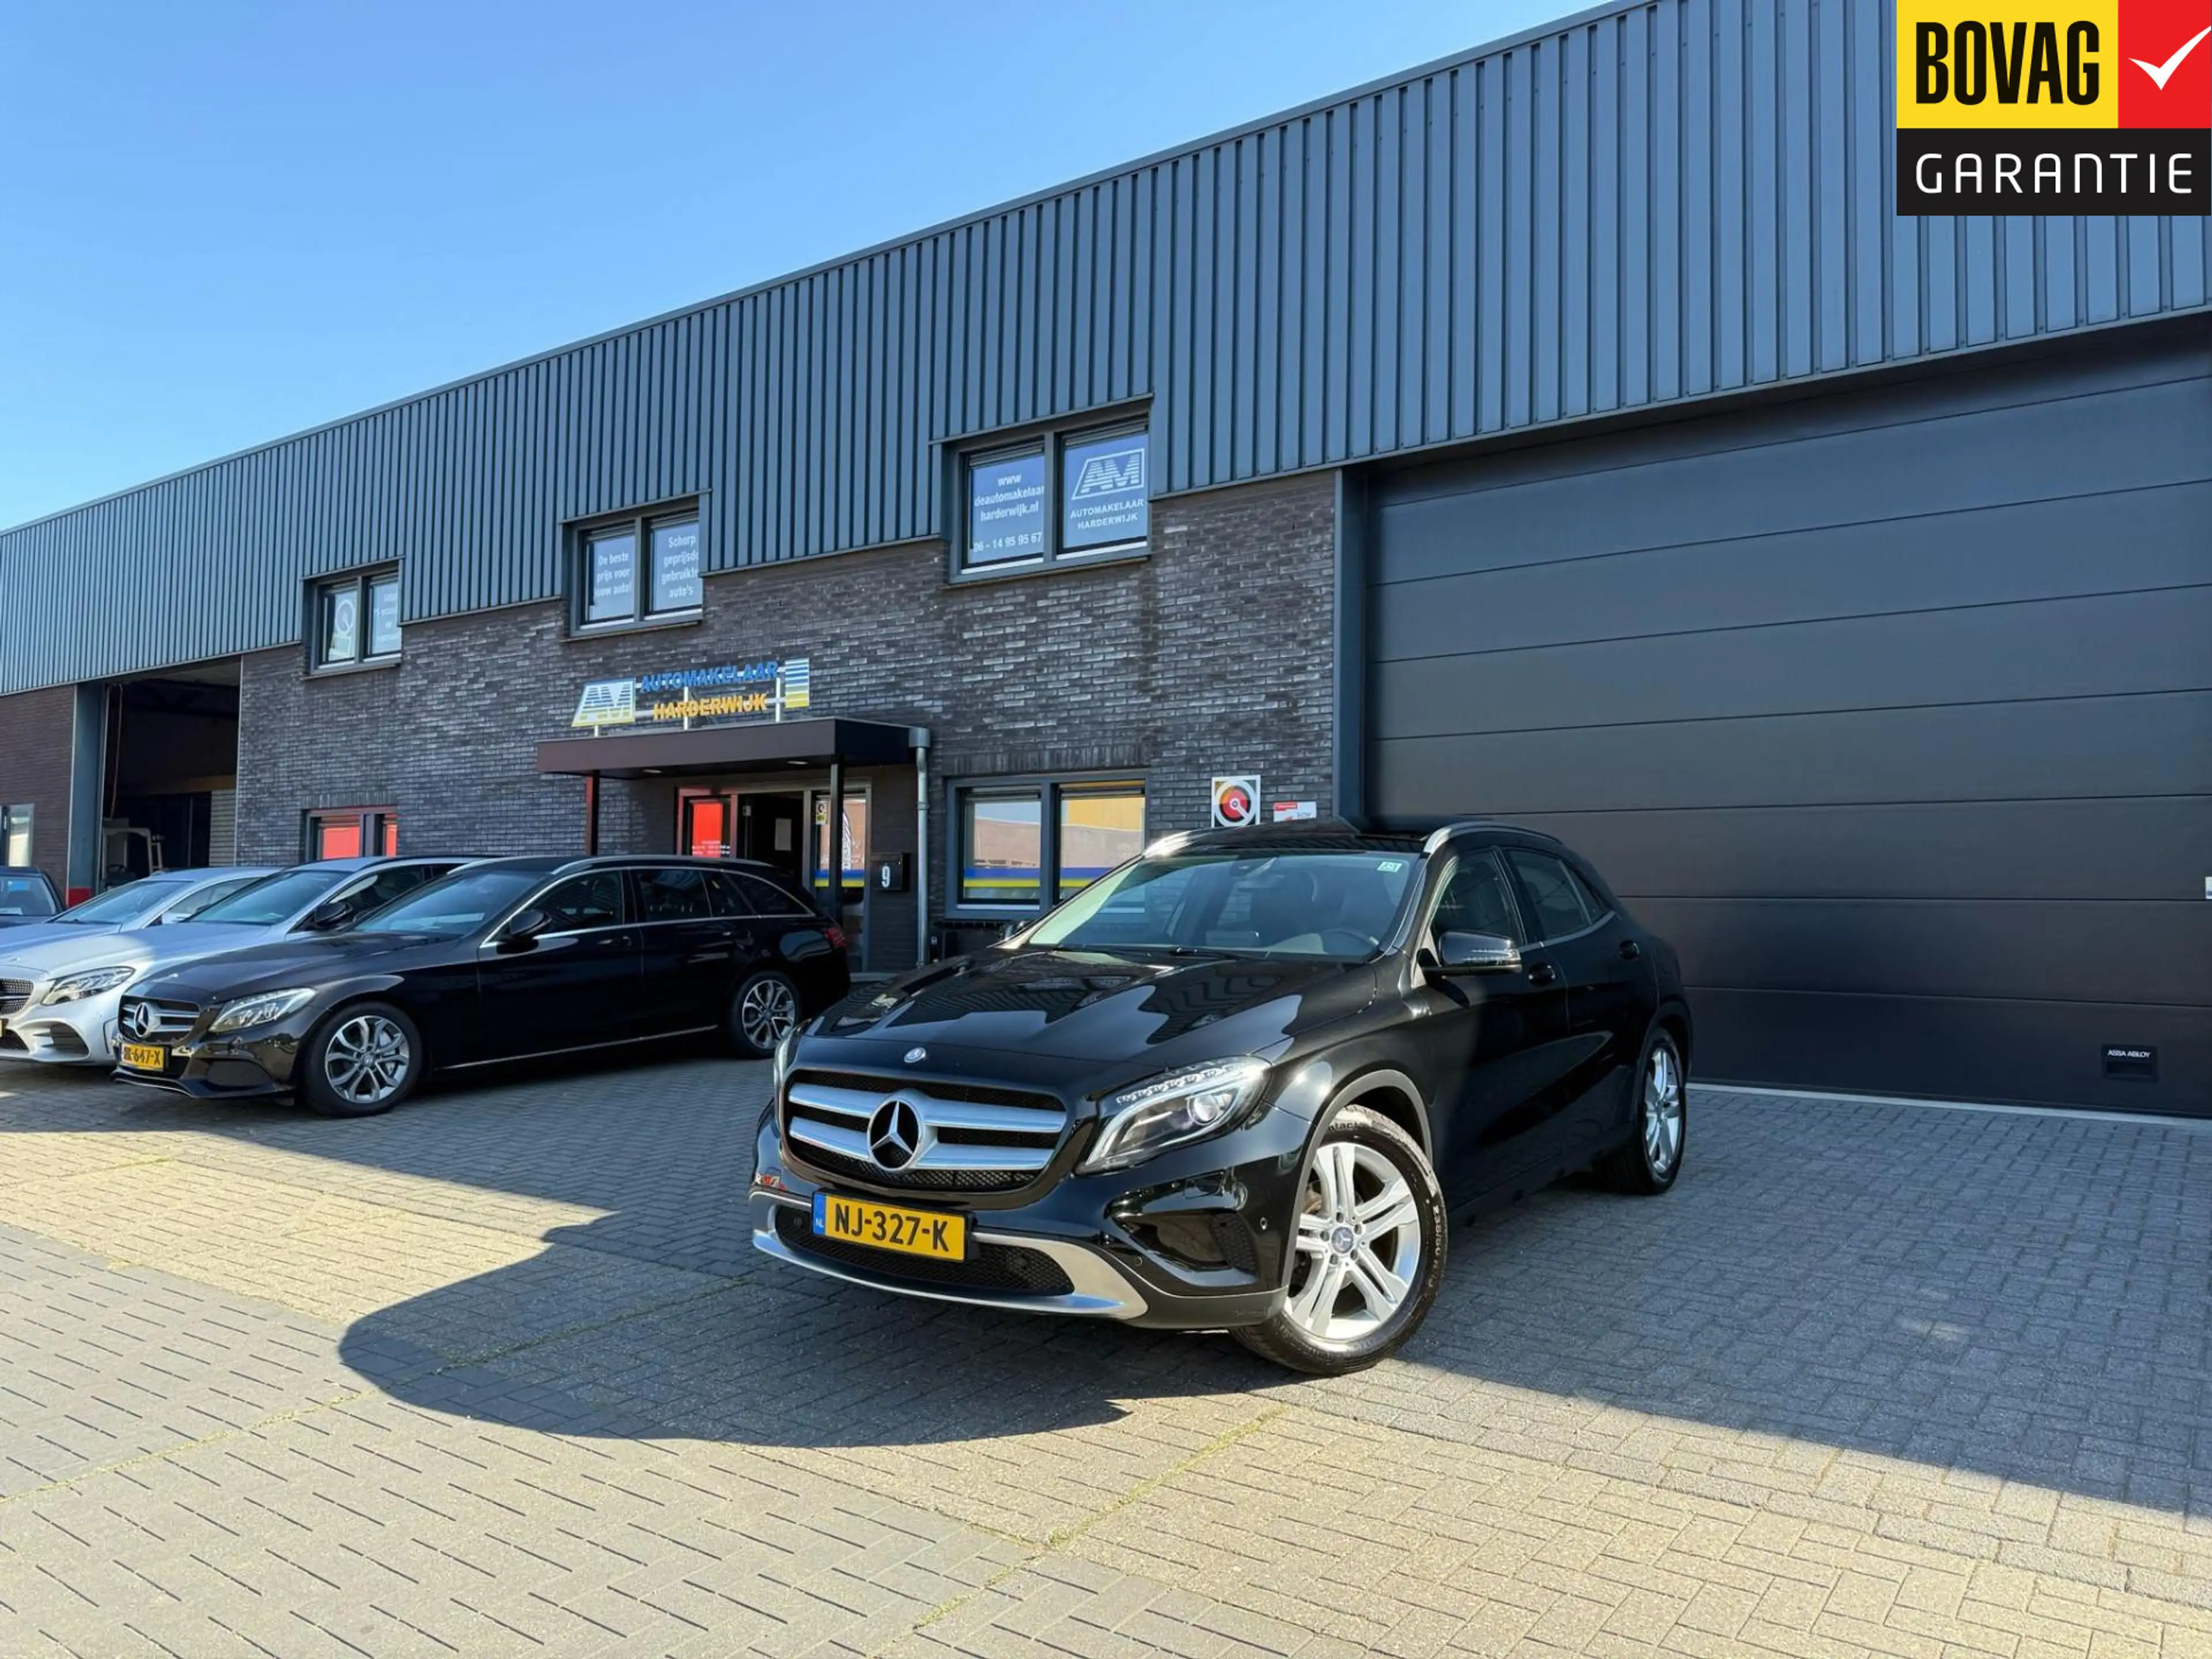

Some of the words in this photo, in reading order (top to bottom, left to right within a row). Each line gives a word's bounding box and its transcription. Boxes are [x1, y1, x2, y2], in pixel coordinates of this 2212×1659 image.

[998, 474, 1022, 487] www
[980, 501, 1039, 522] harderwijk.nl
[1070, 499, 1144, 519] AUTOMAKELAAR
[1078, 512, 1138, 530] HARDERWIJK
[668, 535, 696, 548] Scherp
[993, 538, 1003, 549] 14
[1031, 532, 1042, 543] 67
[639, 661, 779, 692] AUTOMAKELAAR
[653, 692, 768, 721] HARDERWIJK
[881, 866, 891, 888] 9
[815, 1218, 824, 1228] NL
[835, 1203, 949, 1252] NJ-327-K
